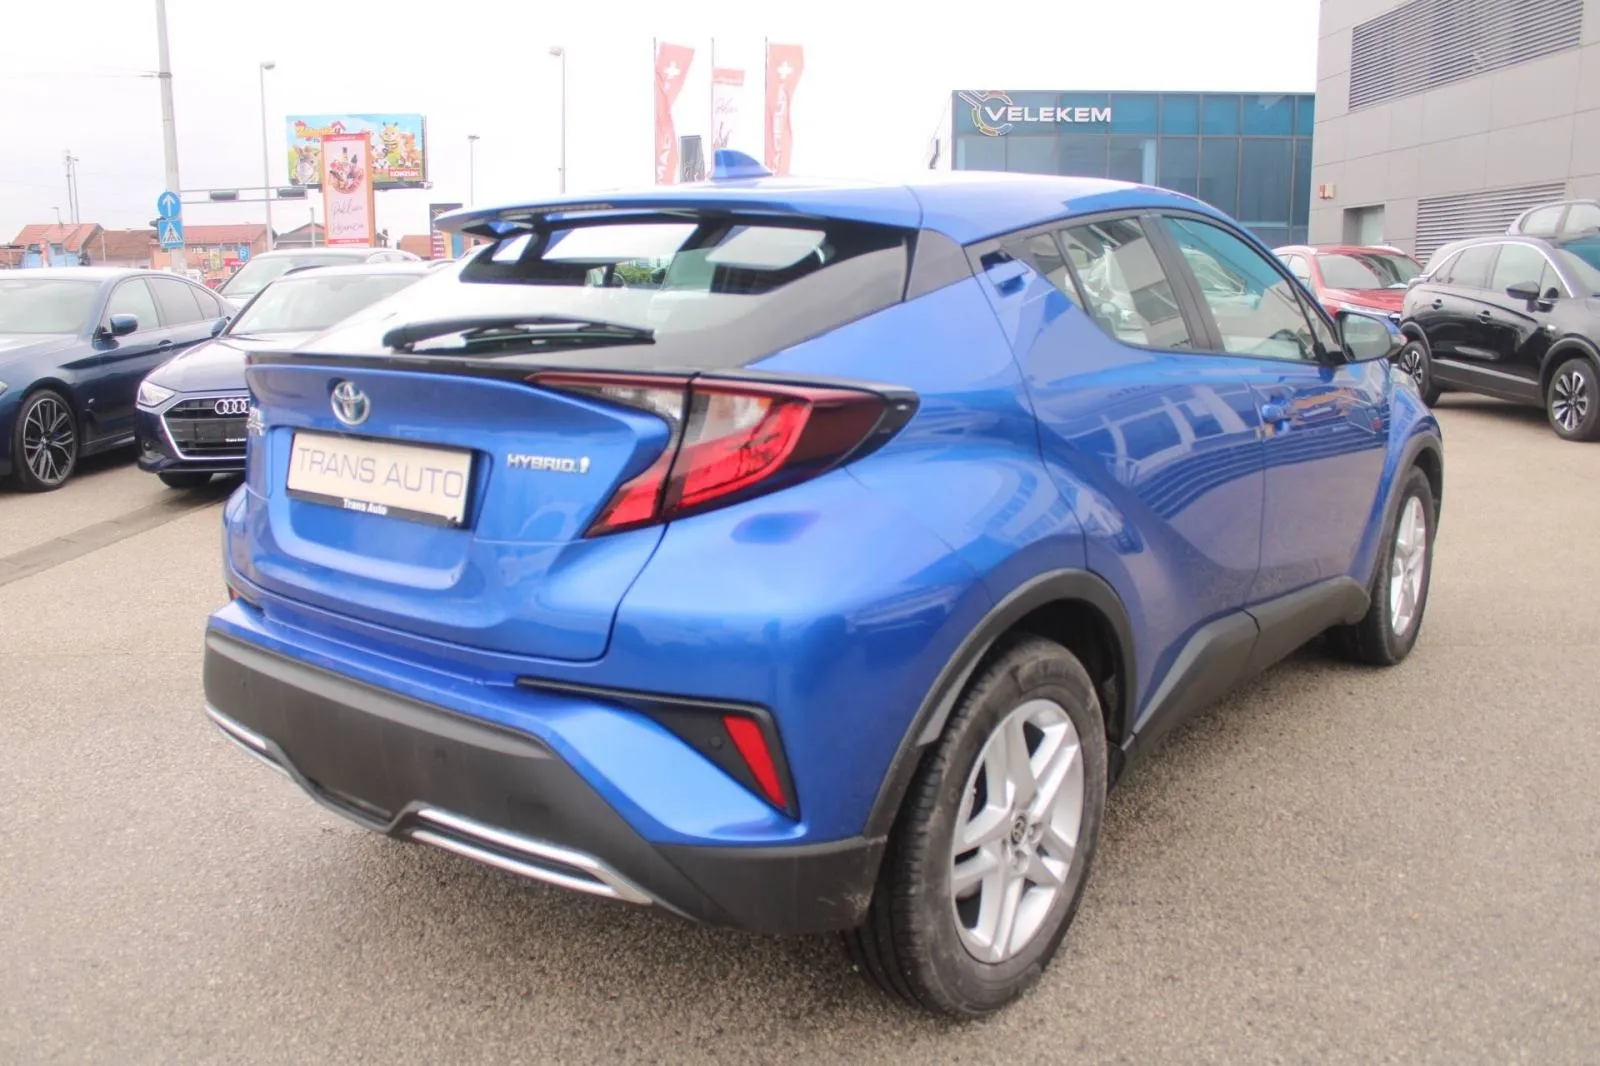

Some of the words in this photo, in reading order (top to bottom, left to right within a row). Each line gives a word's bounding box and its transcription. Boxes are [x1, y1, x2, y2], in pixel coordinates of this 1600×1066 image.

[984, 106, 1112, 122] VELEKEM
[507, 453, 576, 472] HYBRID
[297, 447, 376, 484] TRANS
[383, 461, 464, 499] AUTO
[343, 497, 366, 512] Trans
[367, 502, 388, 515] Auto
